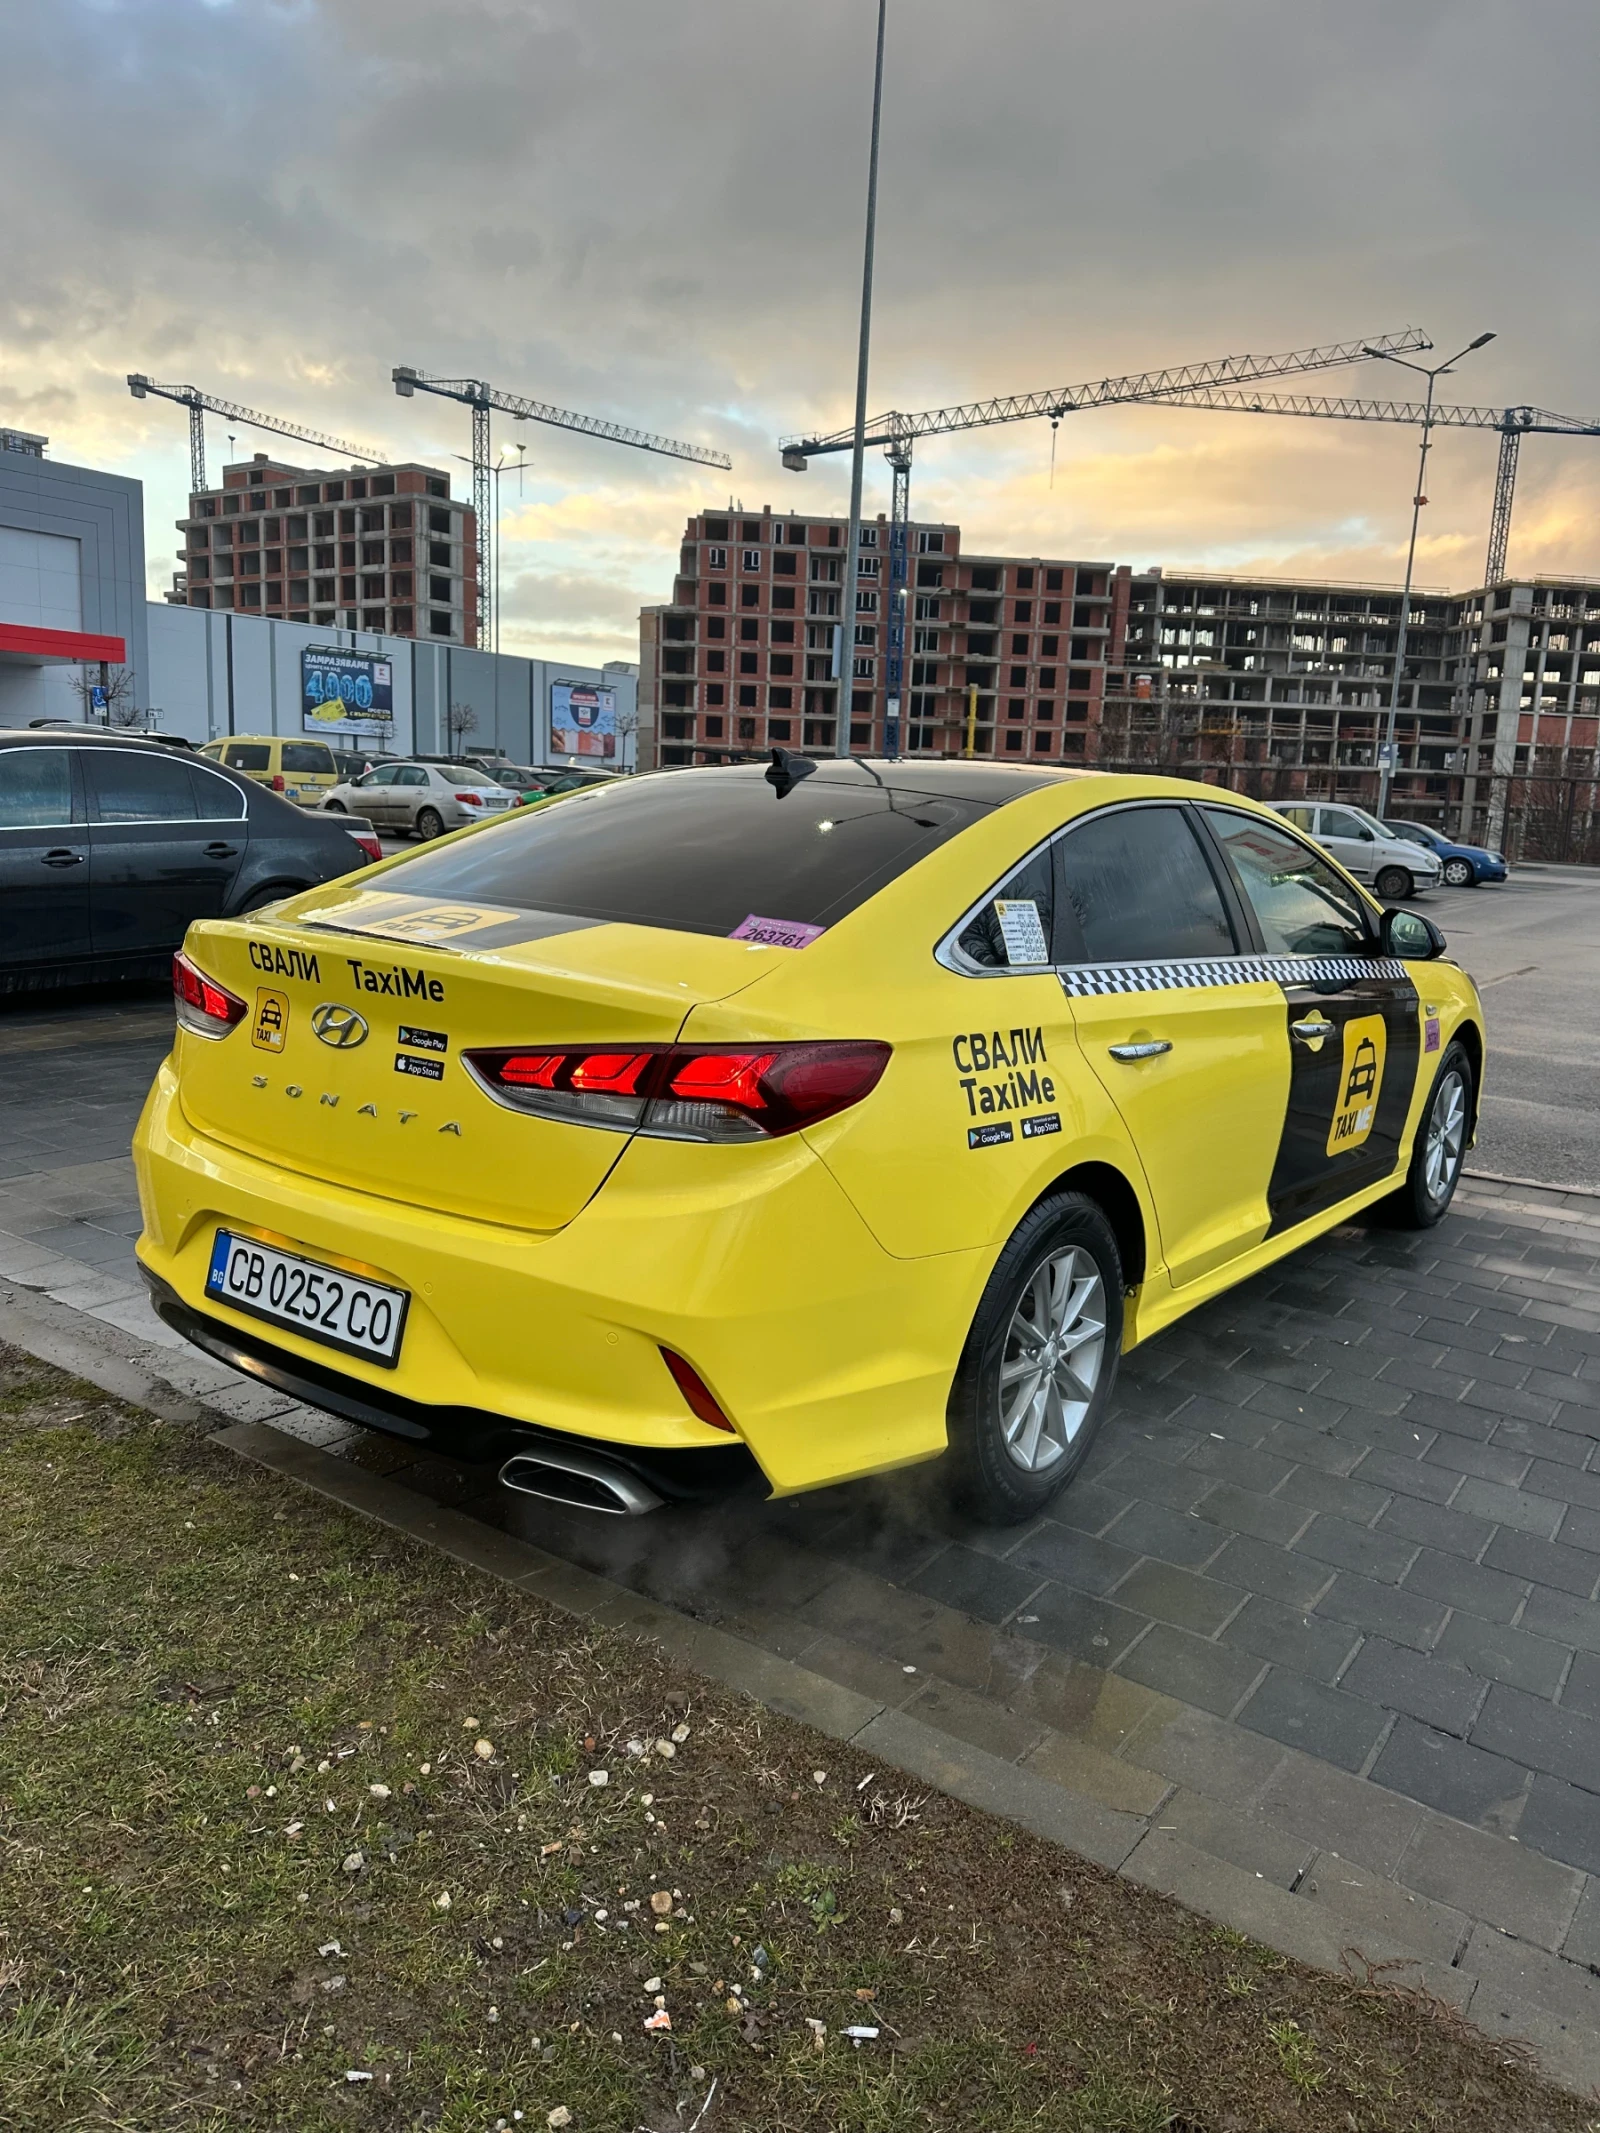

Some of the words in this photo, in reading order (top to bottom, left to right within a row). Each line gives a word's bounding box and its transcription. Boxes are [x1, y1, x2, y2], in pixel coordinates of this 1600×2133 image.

[305, 654, 370, 670] ЗАМРАЗЯВАМЕ
[306, 671, 373, 708] 4000
[743, 928, 806, 947] 263761
[249, 941, 321, 983] СВАЛИ
[347, 959, 444, 1002] TaxiMe
[256, 1028, 281, 1045] TAXIME
[412, 1035, 432, 1047] Google
[433, 1039, 445, 1050] Play
[952, 1026, 1047, 1073] СВАЛИ
[408, 1064, 421, 1075] App
[422, 1066, 439, 1078] Store
[252, 1075, 461, 1136] SONATA
[959, 1069, 1055, 1116] TaxiMe
[981, 1132, 1001, 1143] Google
[1000, 1130, 1011, 1140] Play
[1034, 1124, 1045, 1134] App
[1045, 1122, 1059, 1131] Store
[1334, 1105, 1374, 1141] TAXIME
[212, 1269, 224, 1284] BG
[229, 1248, 265, 1298] CB
[269, 1263, 344, 1330] 0252
